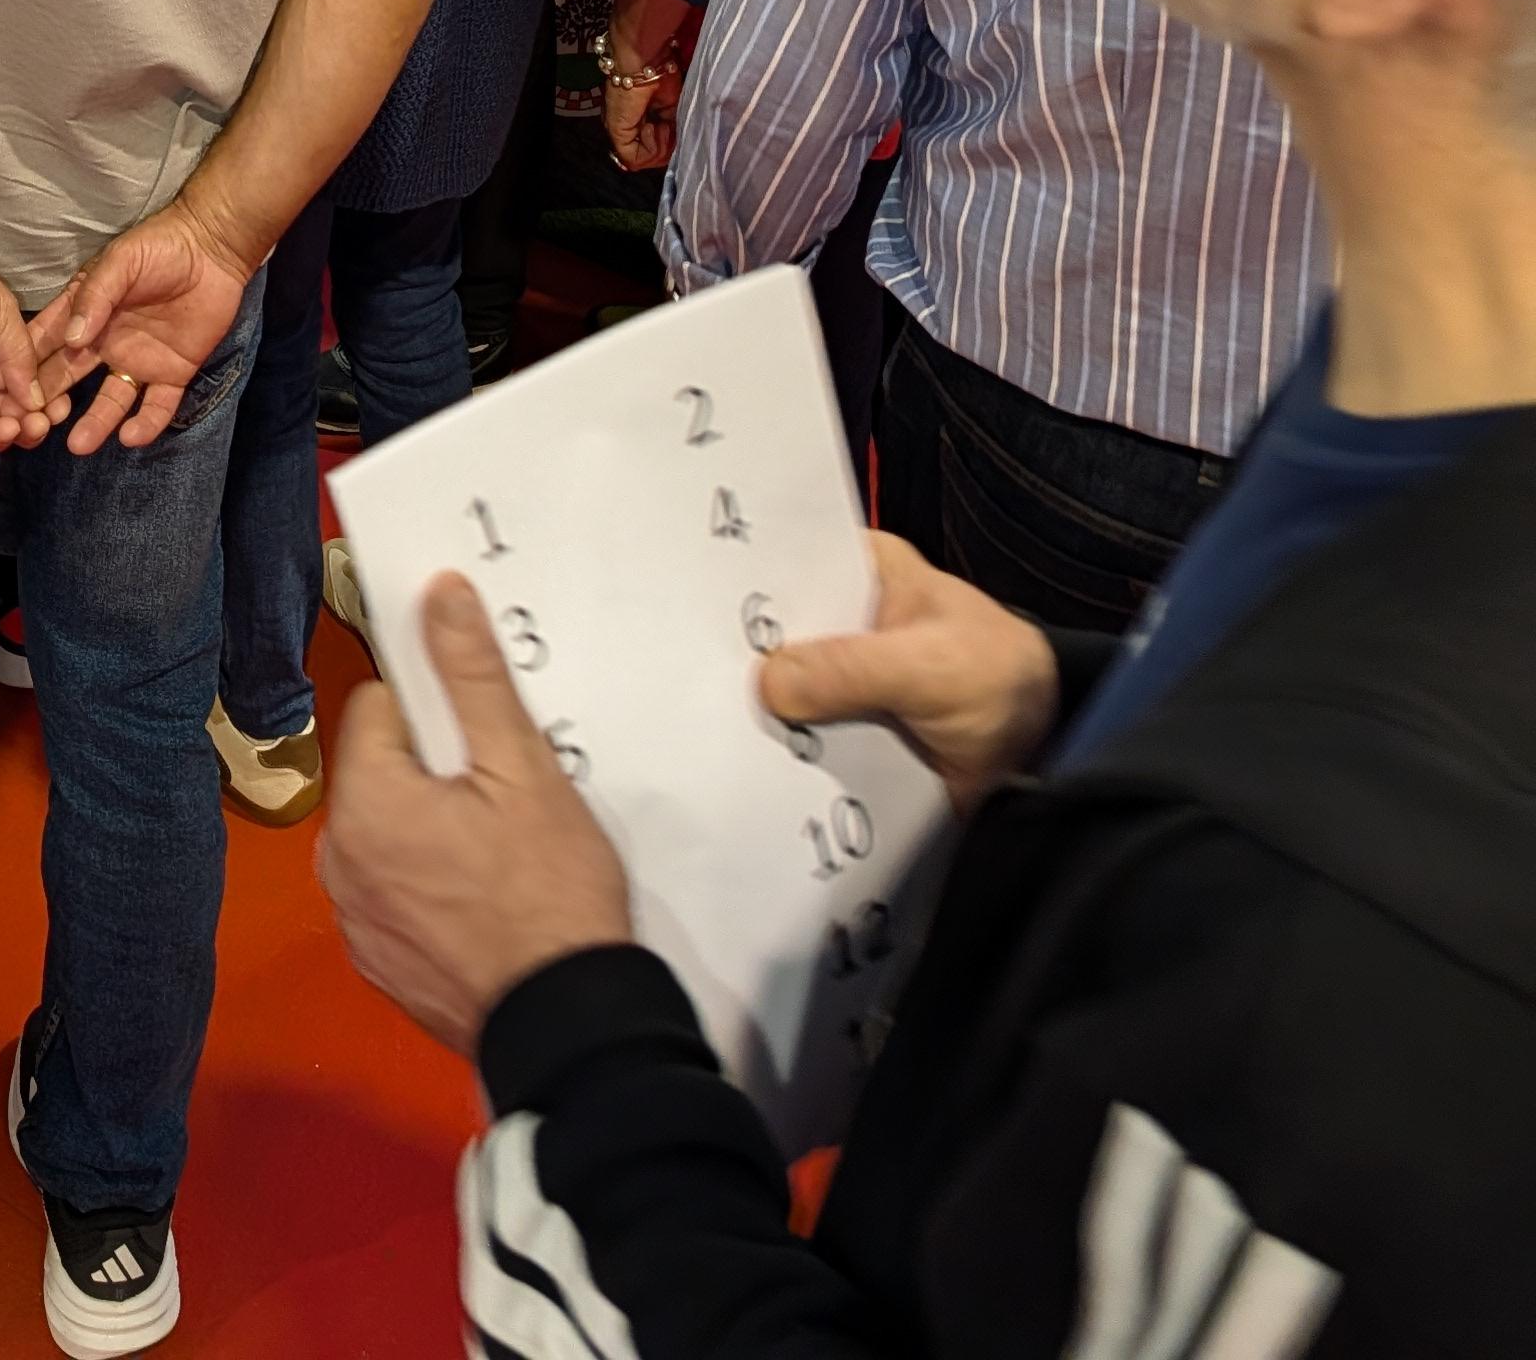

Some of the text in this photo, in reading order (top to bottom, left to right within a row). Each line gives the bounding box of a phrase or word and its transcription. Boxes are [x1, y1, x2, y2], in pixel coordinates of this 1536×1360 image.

[673, 385, 725, 447] 2
[465, 486, 752, 562] 1 4
[500, 591, 784, 674] 3 6
[546, 718, 591, 781] 5
[802, 795, 875, 881] 10
